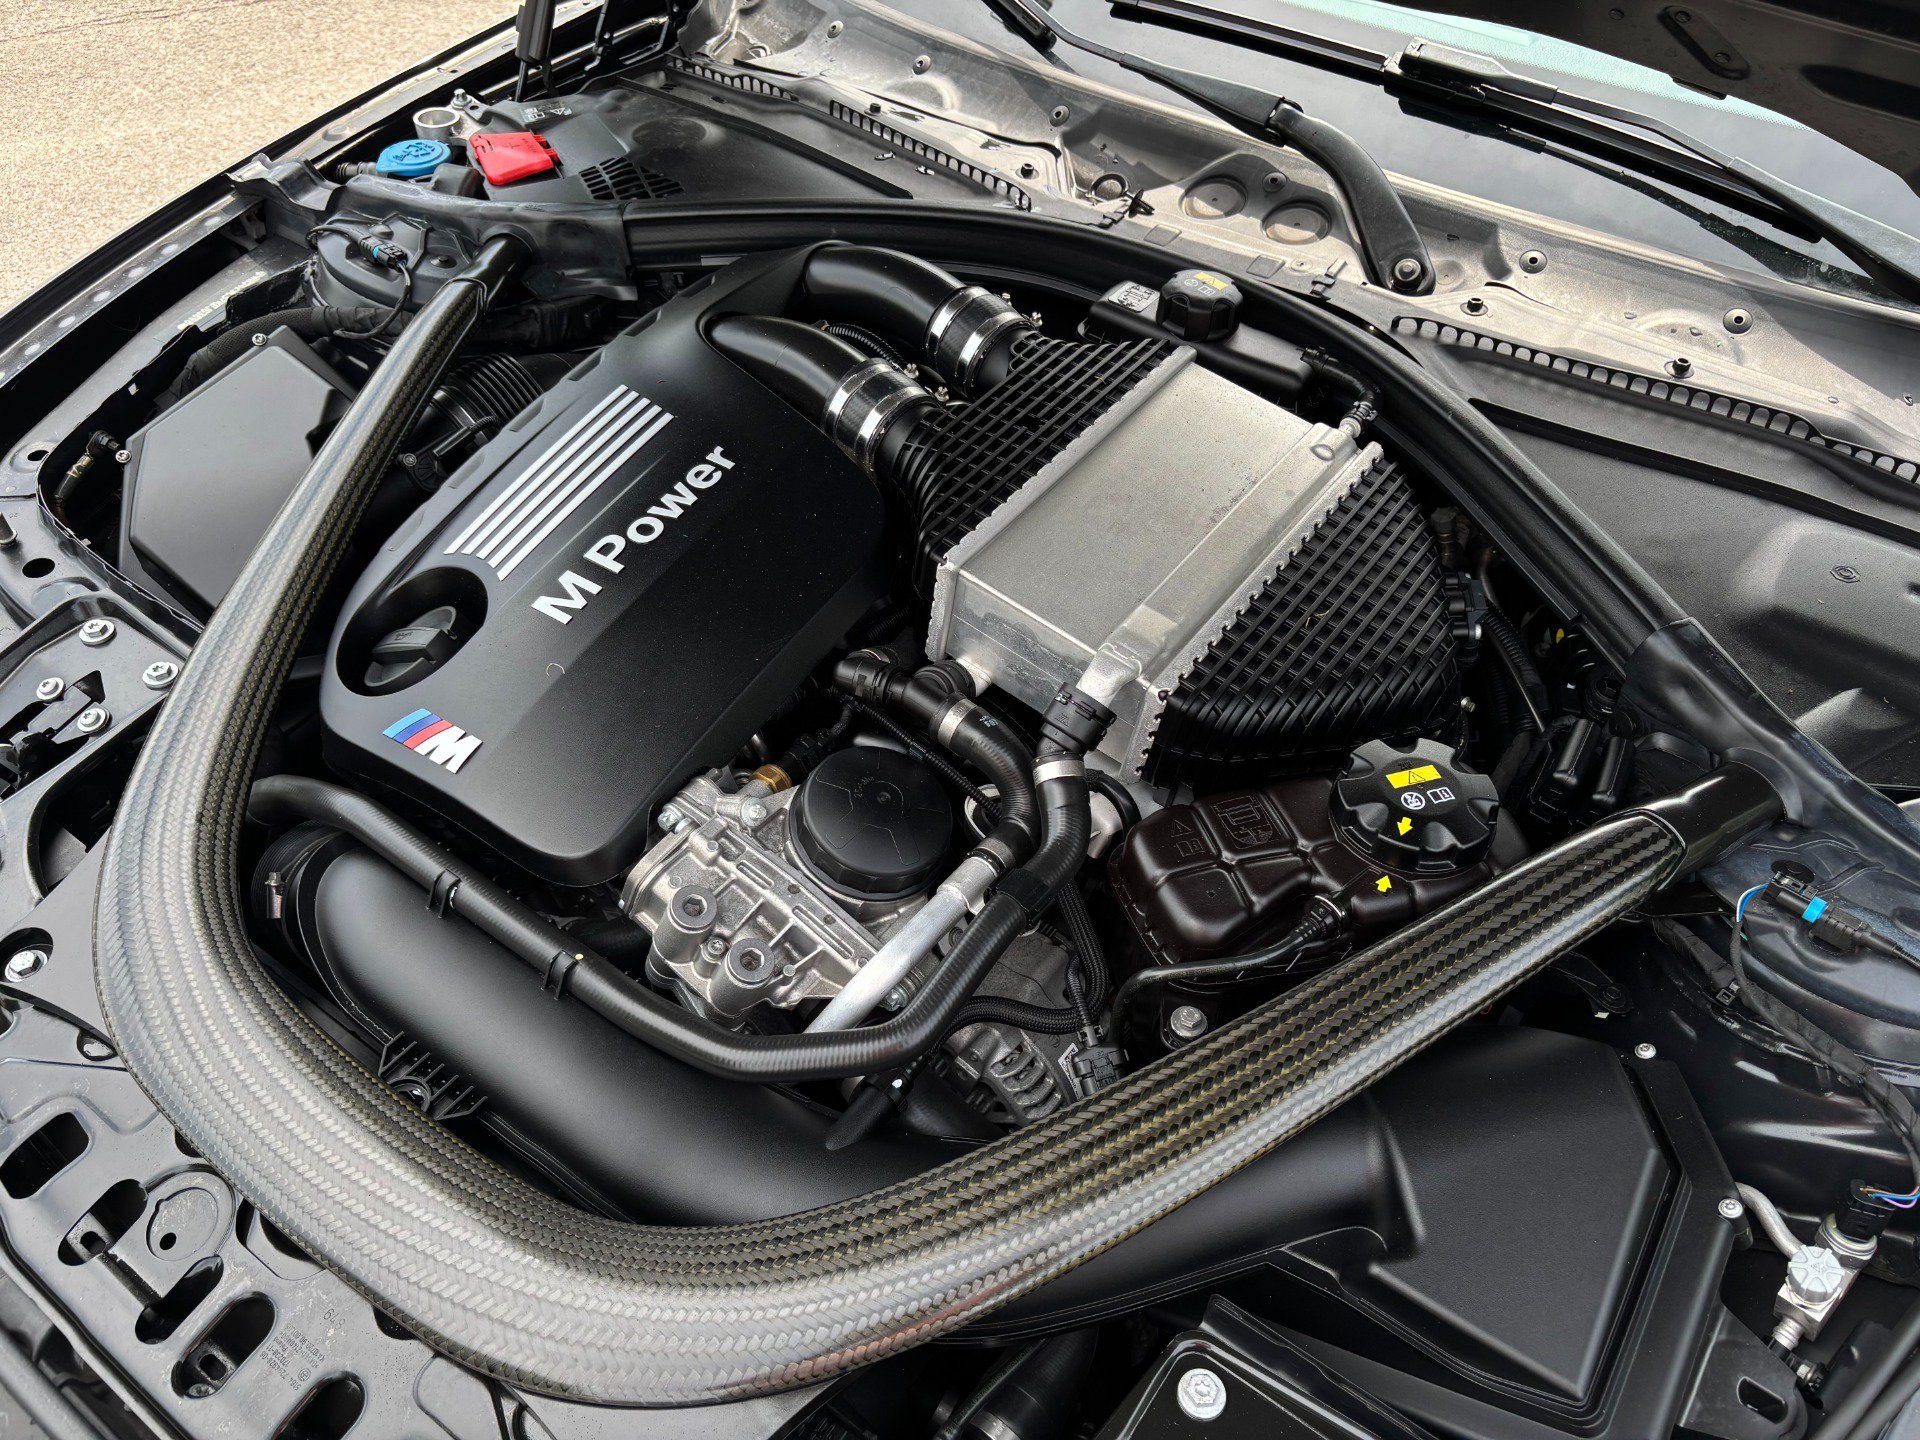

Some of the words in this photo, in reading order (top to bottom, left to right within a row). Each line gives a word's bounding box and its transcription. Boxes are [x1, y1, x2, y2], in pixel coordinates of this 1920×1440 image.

[531, 569, 603, 625] M
[583, 445, 736, 574] Power
[413, 725, 484, 775] M
